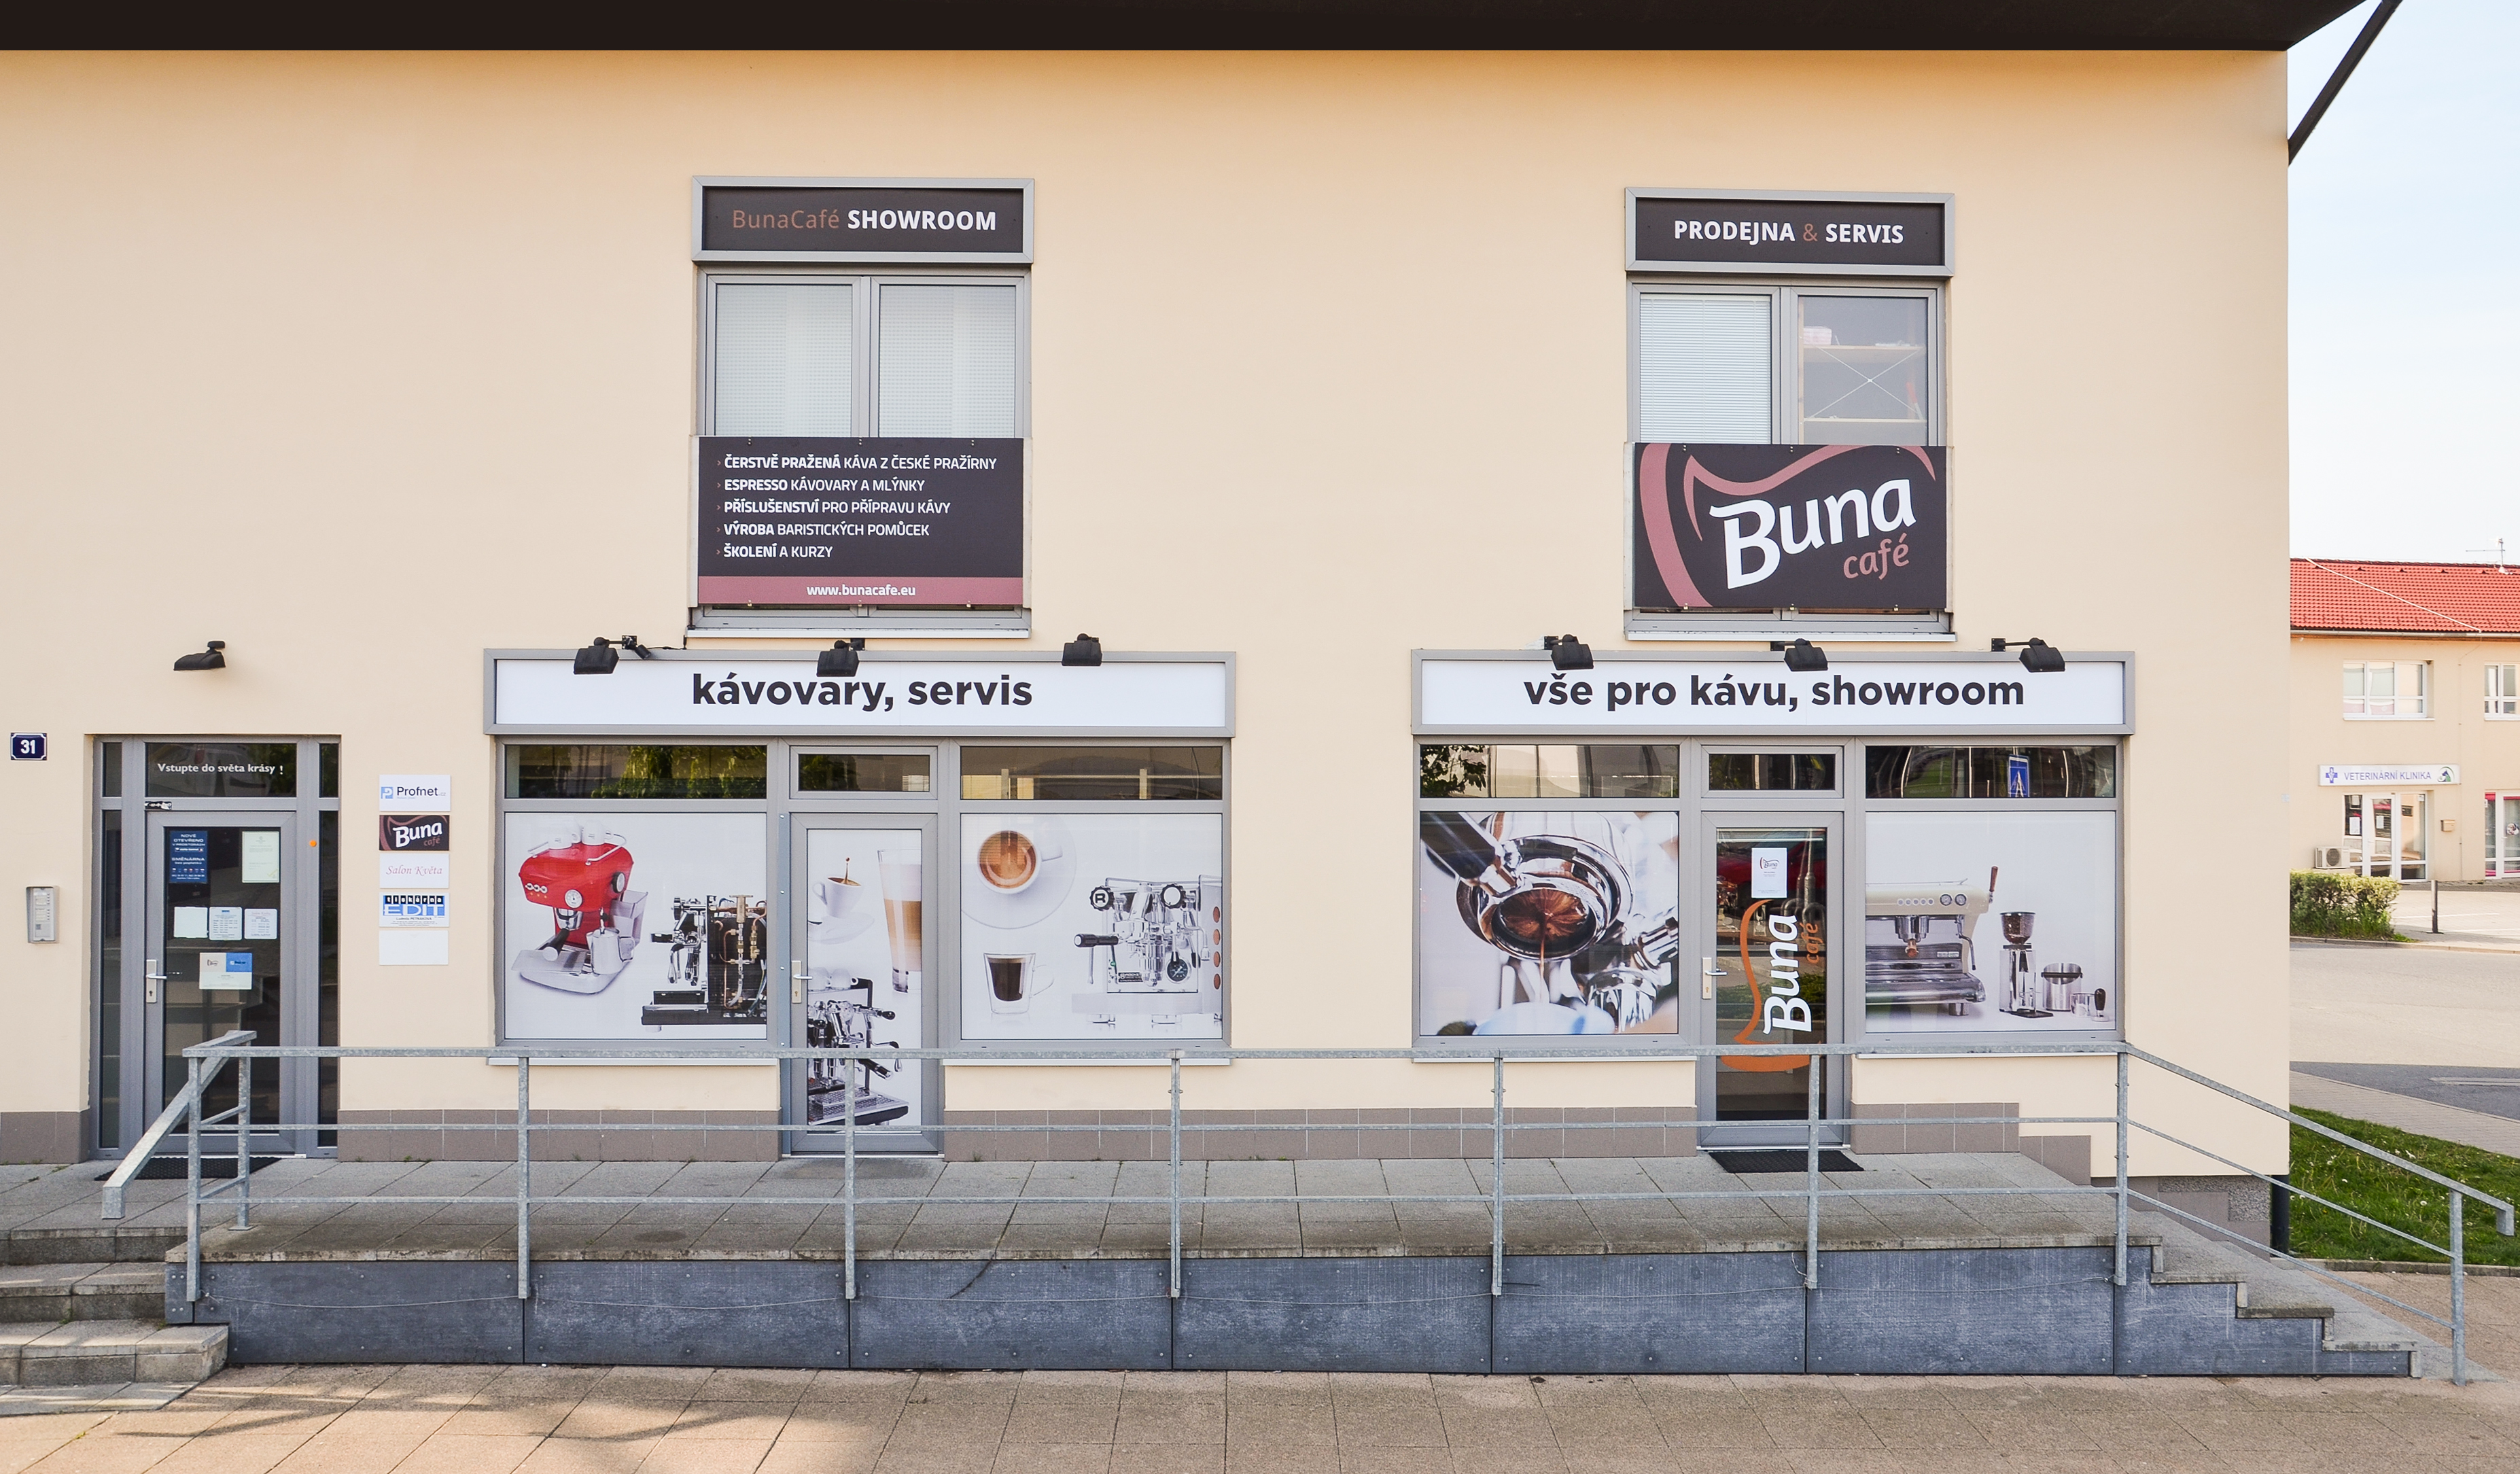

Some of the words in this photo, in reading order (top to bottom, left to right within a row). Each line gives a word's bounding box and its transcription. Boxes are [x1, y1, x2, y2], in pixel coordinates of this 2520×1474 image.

[733, 209, 840, 229] BunaCafé
[847, 209, 997, 230] SHOWROOM
[1674, 220, 1796, 245] PRODEJNA
[1802, 223, 1819, 242] &
[1825, 223, 1904, 243] SERVIS
[724, 453, 779, 470] ČERSTVĚ
[781, 453, 841, 470] PRAŽENÁ
[843, 453, 877, 470] KÁVA
[880, 457, 889, 470] Z
[890, 454, 930, 470] ČESKÉ
[933, 454, 998, 470] PRAŽÍRNY
[724, 478, 788, 491] ESPRESSO
[790, 476, 858, 491] KÁVOVARY
[860, 479, 870, 491] A
[872, 476, 926, 491] MLÝNKY
[724, 498, 820, 514] PŘÍSLUŠENSTVÍ
[821, 502, 849, 514] PRO
[851, 499, 915, 514] PŘÍPRAVU
[917, 499, 951, 514] KÁVY
[723, 521, 775, 536] VÝROBA
[777, 521, 864, 536] BARISTICKÝCH
[867, 521, 930, 536] POMŮCEK
[1709, 478, 1917, 590] Buna
[723, 542, 777, 558] ŠKOLENÍ
[779, 546, 789, 558] A
[790, 546, 833, 558] KURZY
[1842, 532, 1910, 581] café
[806, 584, 916, 597] www.bunacafe.eu
[692, 671, 894, 712] kávovary,
[907, 673, 1033, 706] servis
[1523, 672, 1593, 706] vše
[1607, 681, 1677, 712] pro
[1690, 673, 1798, 712] kávu,
[1810, 673, 2025, 706] showroom
[20, 739, 35, 754] 31
[157, 762, 199, 775] Vstupte
[201, 762, 215, 773] do
[217, 762, 245, 773] světa
[247, 762, 275, 775] krásy
[279, 765, 284, 775] !
[2344, 769, 2398, 781] VETERINÁRNÍ
[2400, 771, 2432, 780] KLINIKA
[392, 822, 443, 848] Buna
[423, 836, 441, 847] café
[385, 864, 413, 875] Salon
[414, 866, 443, 877] Květa
[383, 904, 444, 916] EDIT
[1799, 922, 1824, 964] café
[1762, 914, 1813, 1035] Buna
